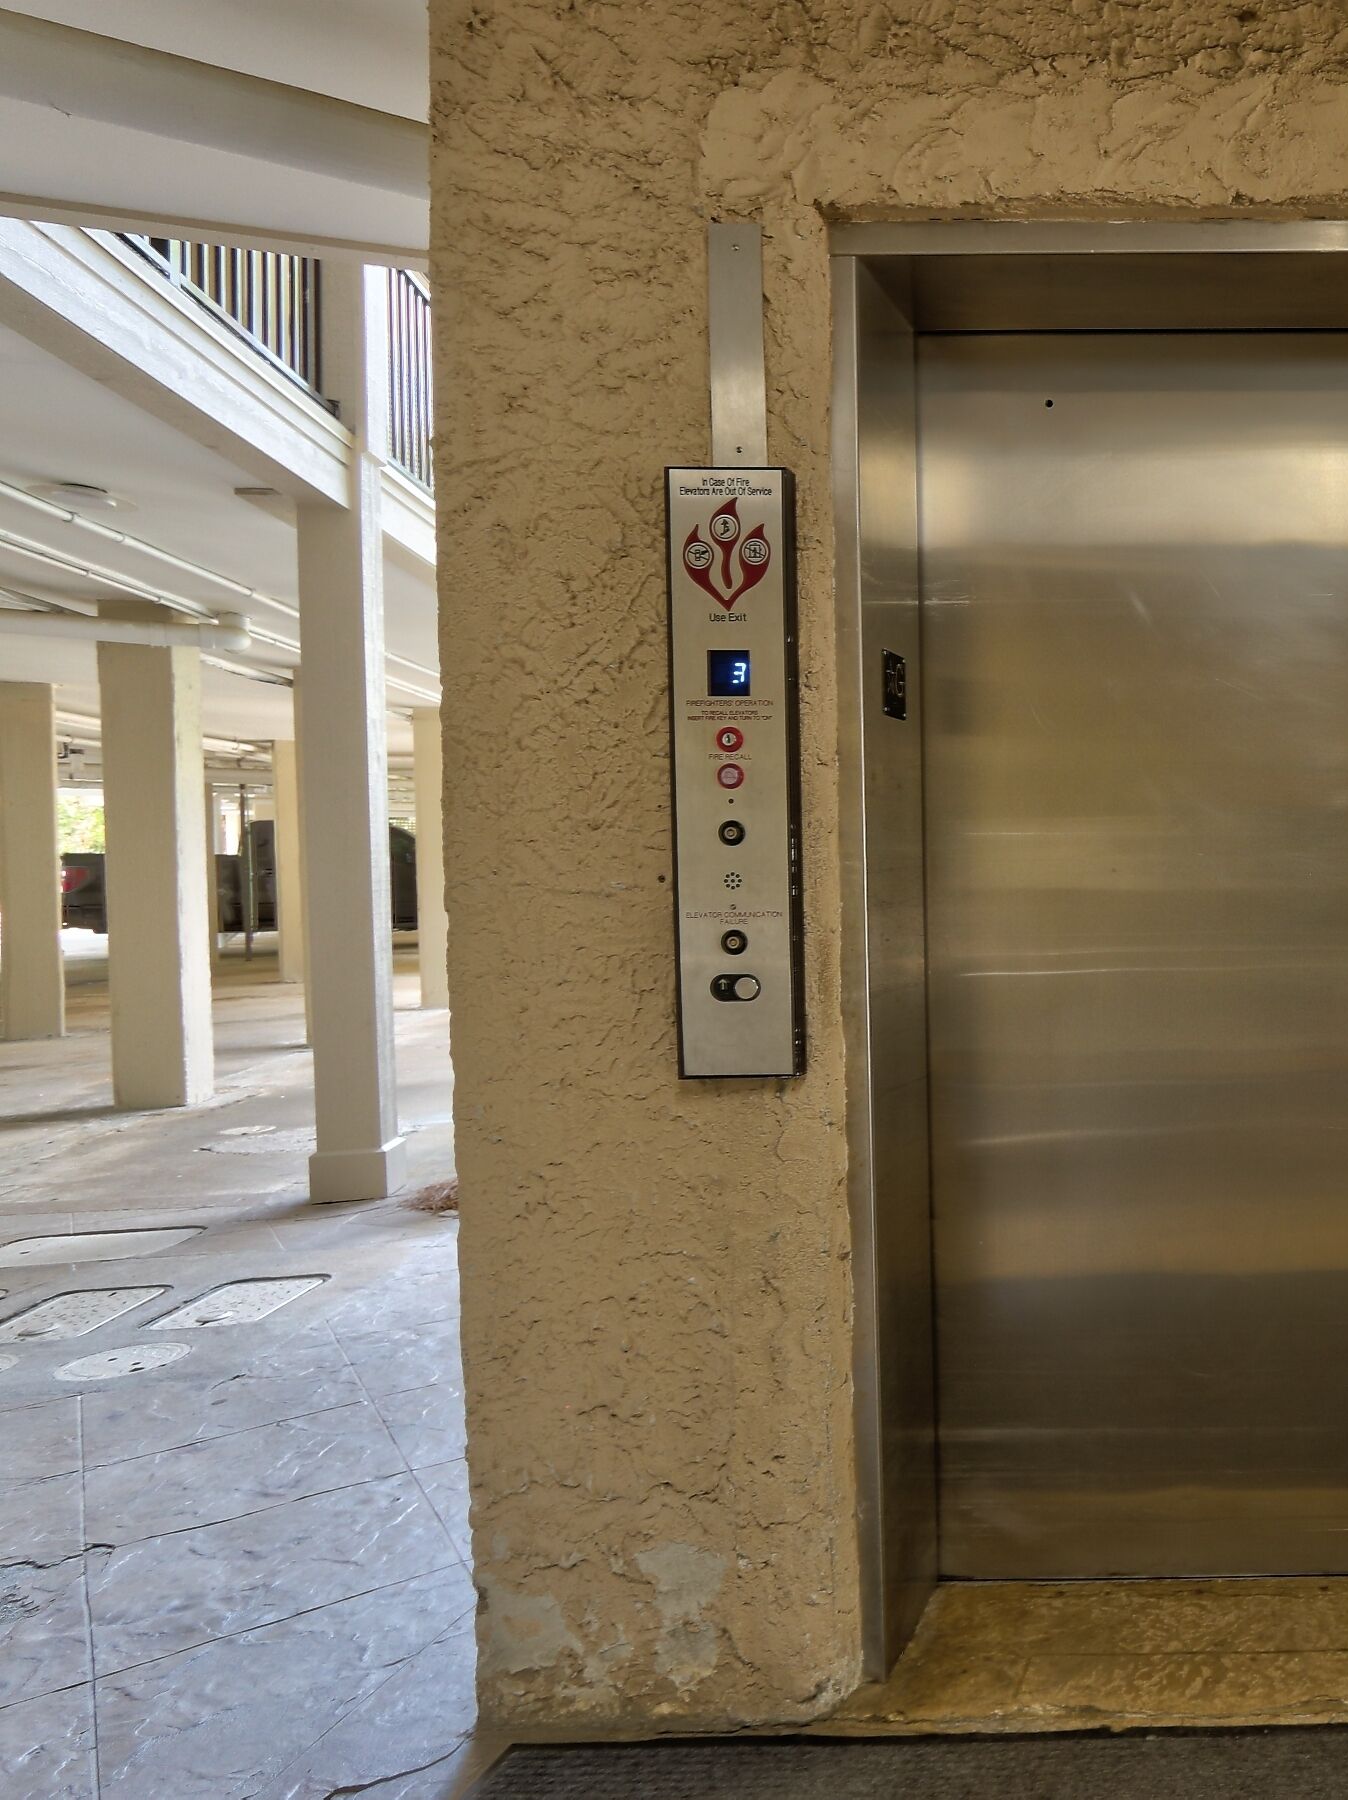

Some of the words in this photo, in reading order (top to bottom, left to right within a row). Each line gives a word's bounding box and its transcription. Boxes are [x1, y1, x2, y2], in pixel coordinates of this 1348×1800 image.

[702, 478, 707, 486] In
[709, 478, 725, 486] Case
[727, 478, 735, 486] Of
[736, 478, 750, 486] Fire
[680, 487, 710, 496] Elevators
[711, 487, 722, 496] Are
[724, 487, 736, 496] Out
[738, 487, 746, 496] Of
[747, 487, 772, 496] Service
[709, 613, 726, 622] Use
[728, 613, 747, 622] Exit
[732, 663, 746, 683] 3
